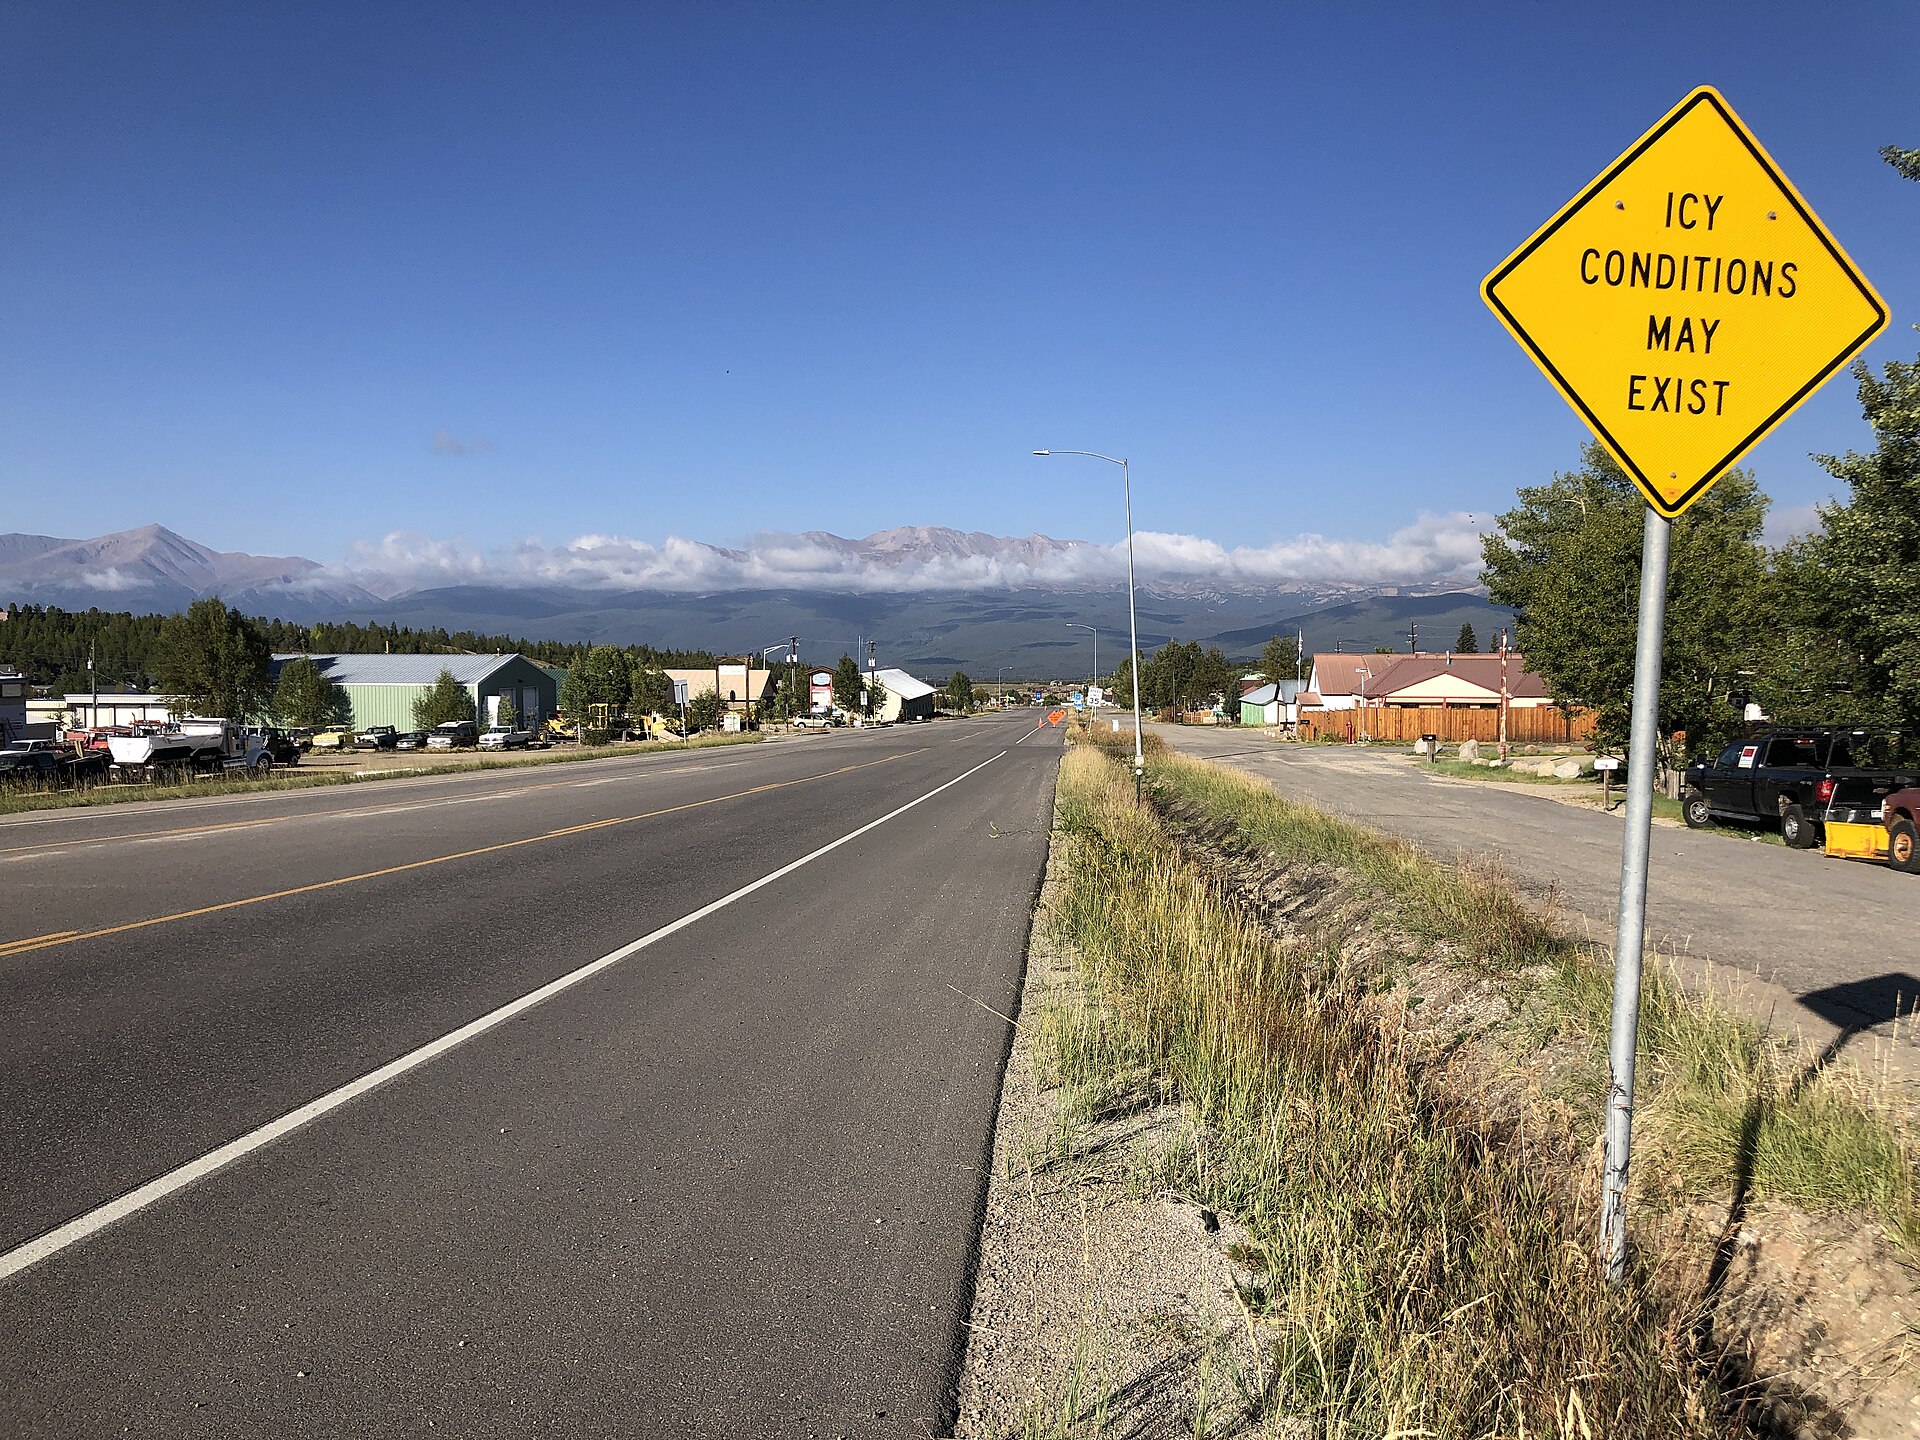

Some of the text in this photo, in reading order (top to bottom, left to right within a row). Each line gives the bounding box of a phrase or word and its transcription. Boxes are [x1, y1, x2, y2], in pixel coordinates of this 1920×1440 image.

[1665, 192, 1724, 231] ICY
[1580, 248, 1798, 299] CONDITIONS
[1646, 314, 1721, 355] MAY
[1627, 374, 1730, 416] EXIST
[1089, 697, 1100, 705] 35
